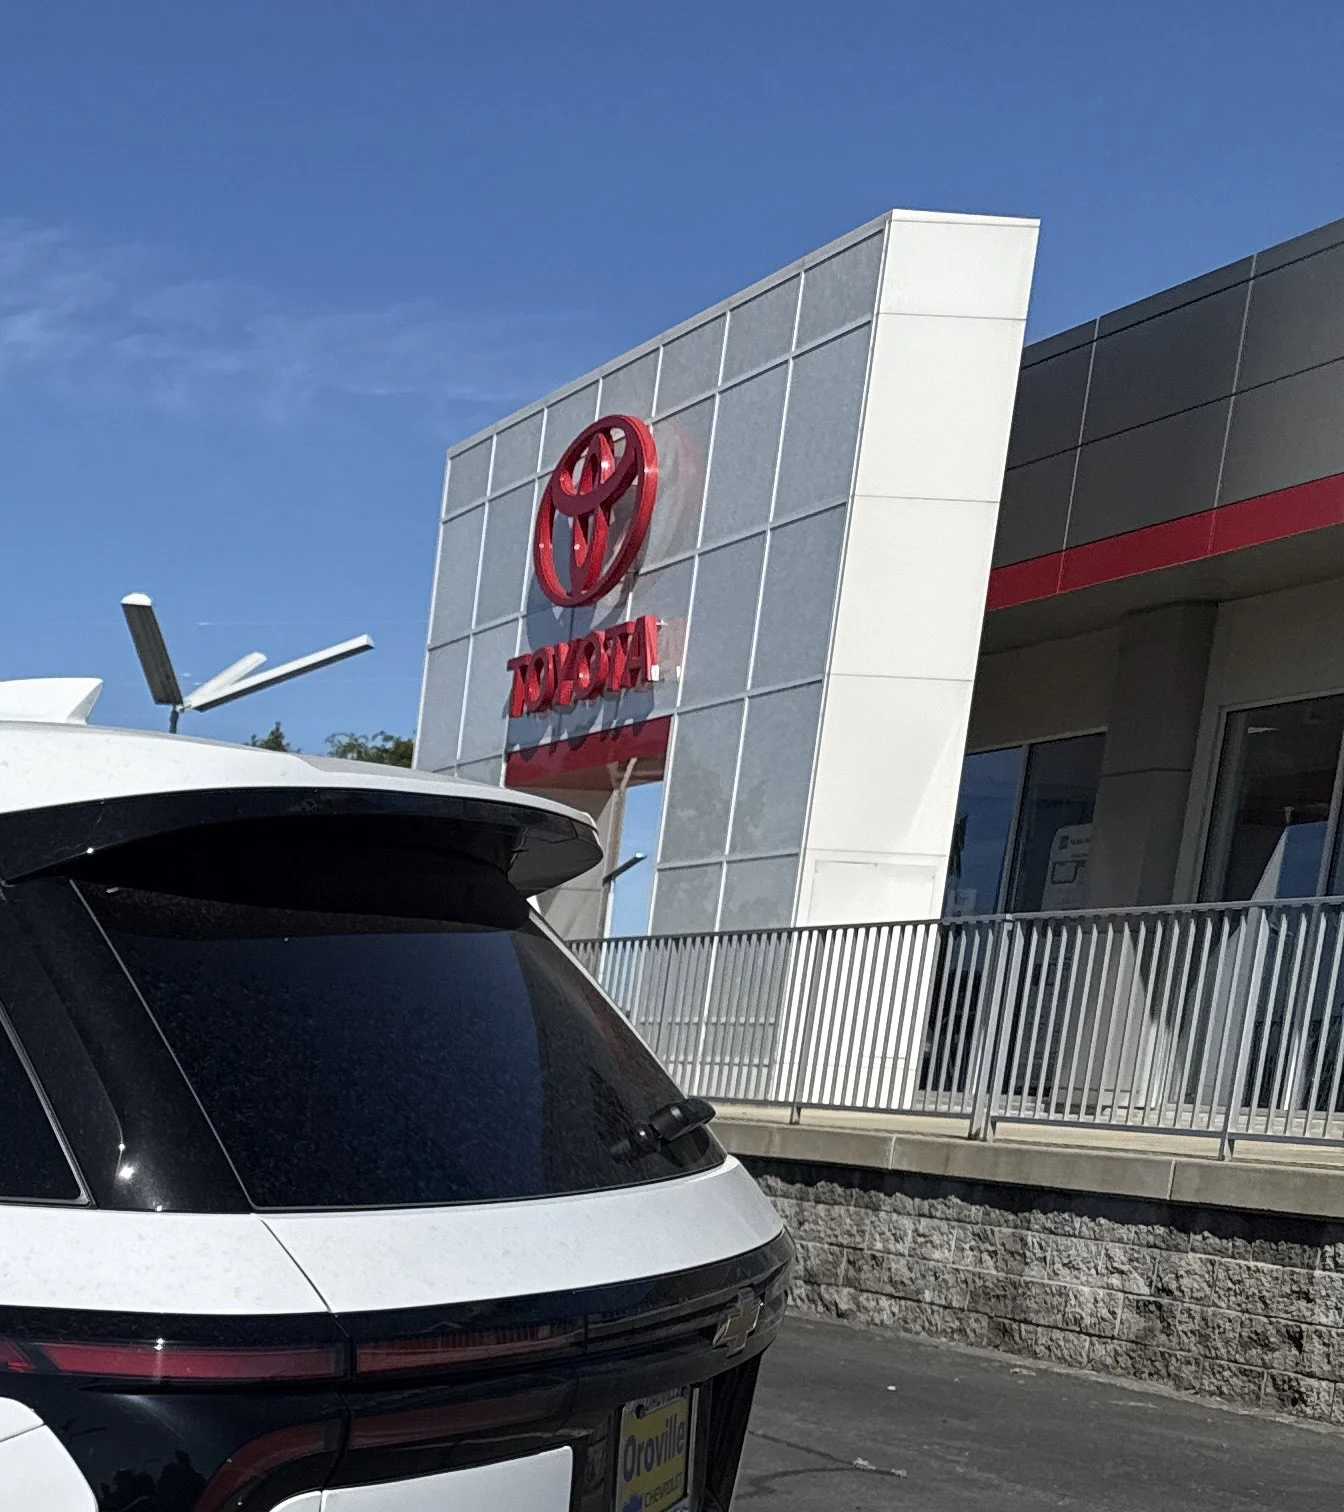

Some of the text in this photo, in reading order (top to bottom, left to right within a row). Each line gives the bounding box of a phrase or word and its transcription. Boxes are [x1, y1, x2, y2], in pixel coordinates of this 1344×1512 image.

[507, 614, 659, 719] TOYOTA
[623, 1413, 686, 1483] Oroville
[644, 1472, 683, 1508] CHEVROLET
